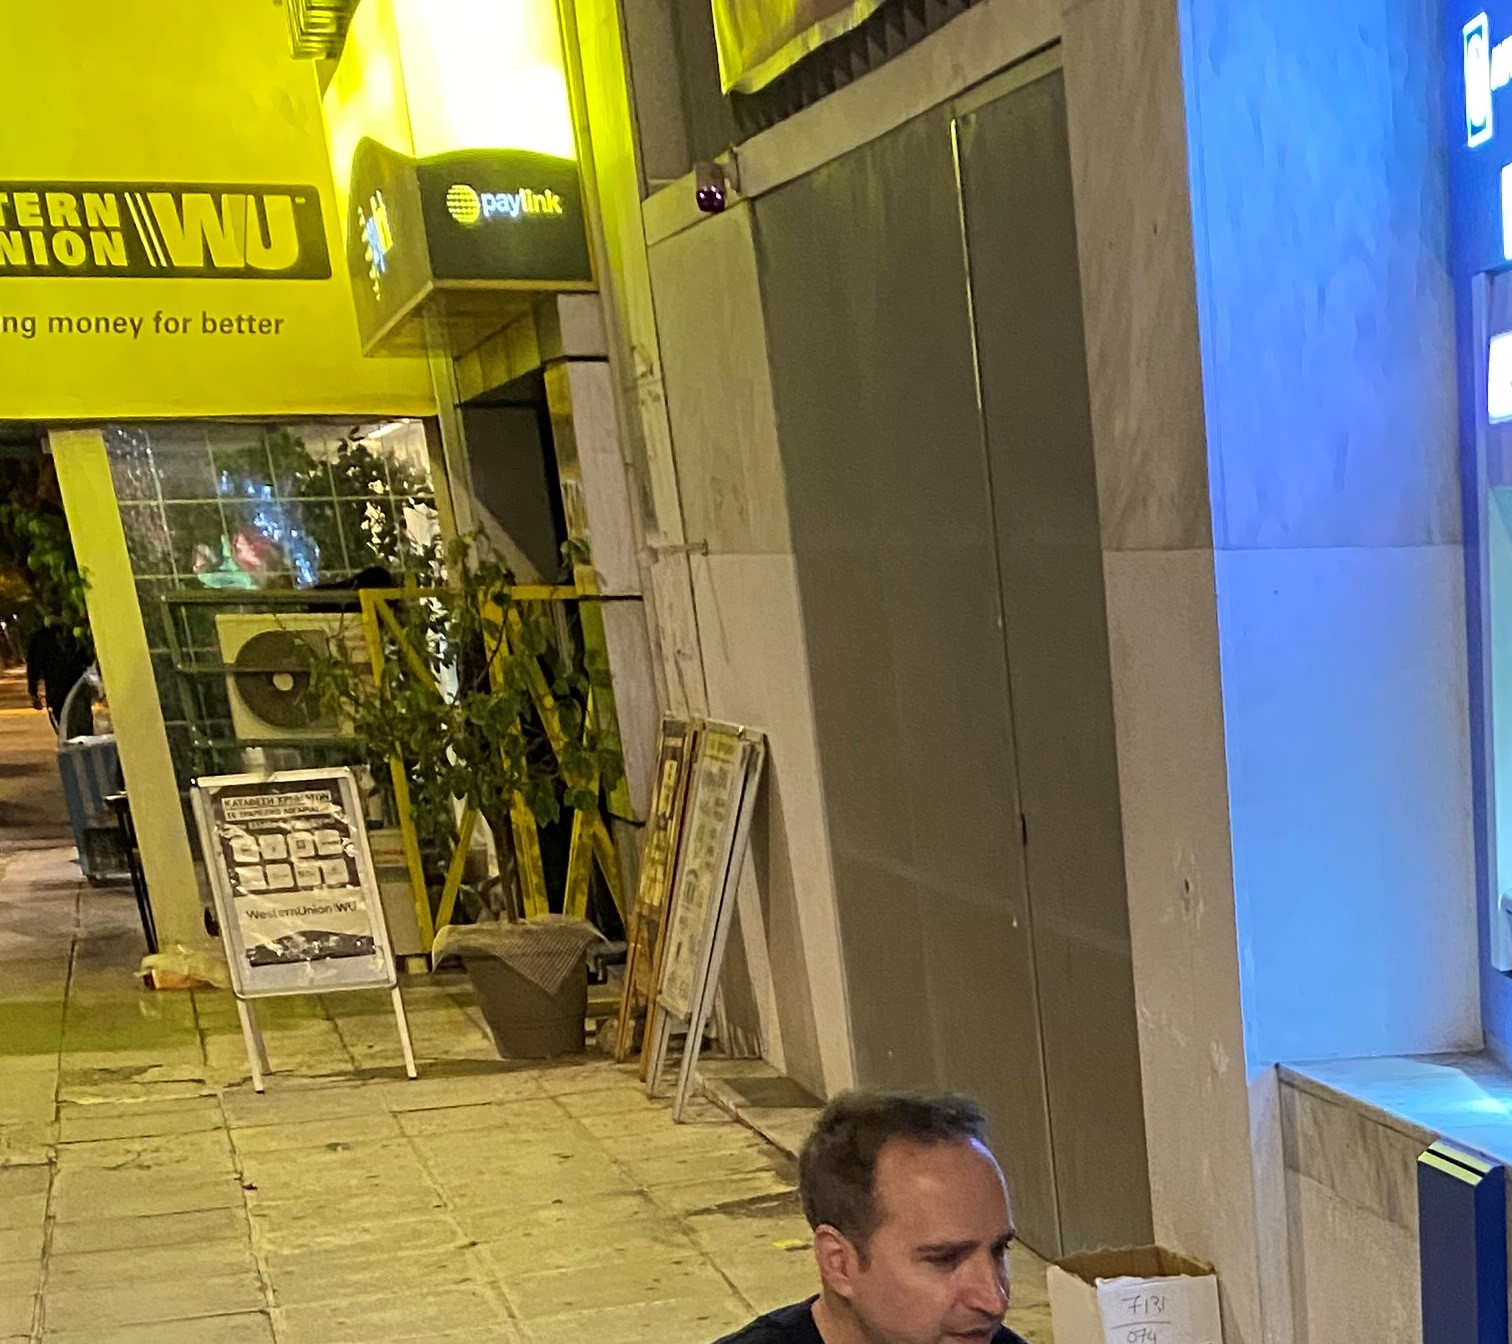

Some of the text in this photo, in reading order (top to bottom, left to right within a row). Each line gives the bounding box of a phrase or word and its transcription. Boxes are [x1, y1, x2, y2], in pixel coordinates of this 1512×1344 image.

[0, 192, 121, 228] ERN
[480, 187, 563, 218] paylink
[147, 192, 299, 271] WU
[48, 316, 144, 340] money
[154, 310, 192, 335] for
[202, 311, 285, 335] better
